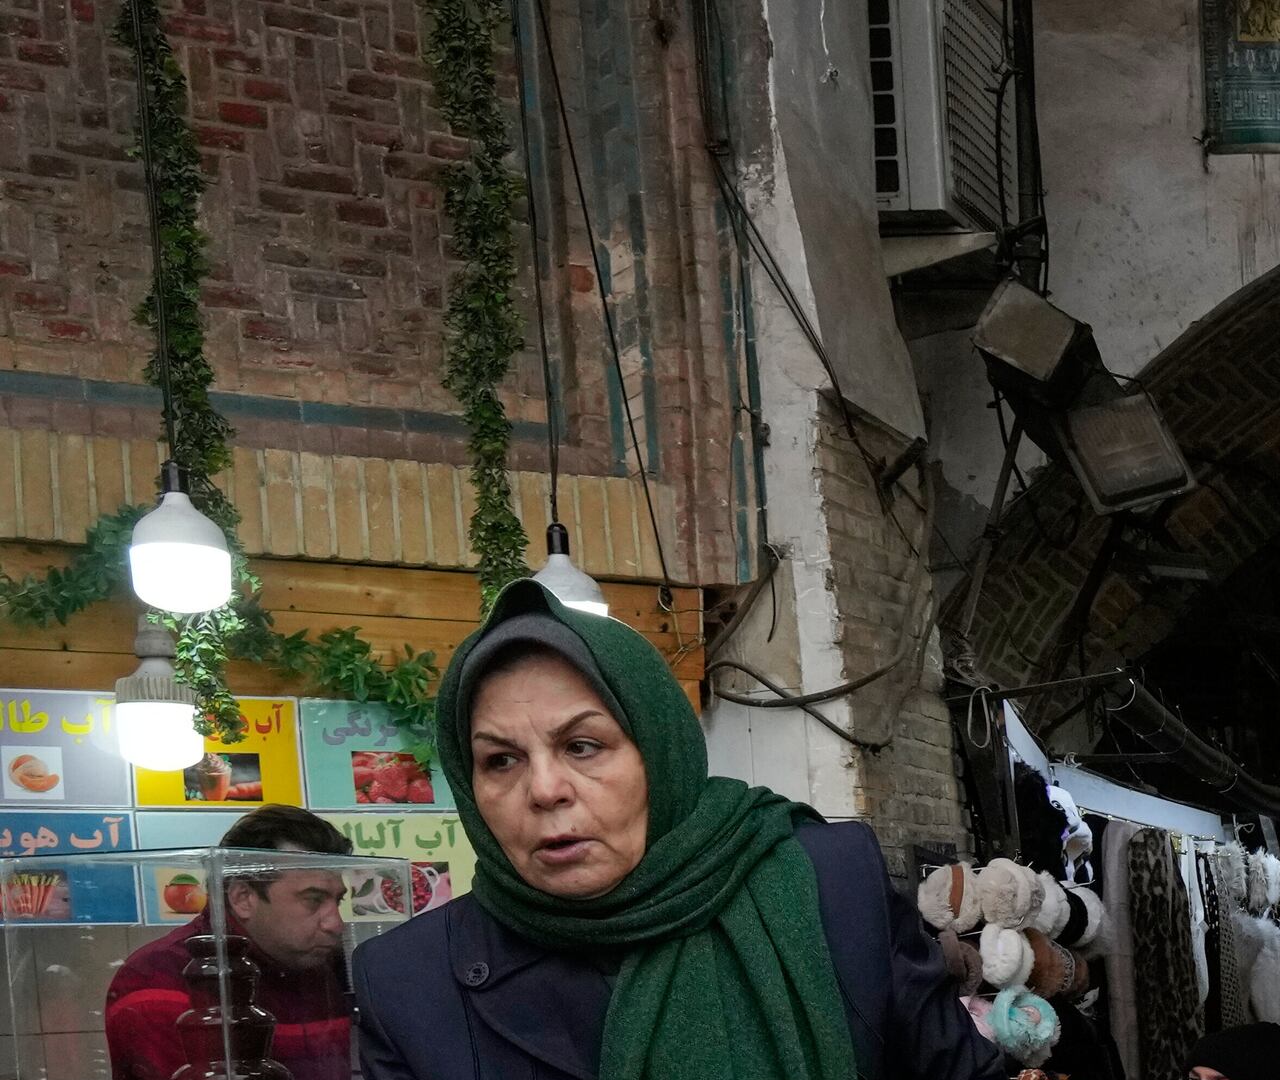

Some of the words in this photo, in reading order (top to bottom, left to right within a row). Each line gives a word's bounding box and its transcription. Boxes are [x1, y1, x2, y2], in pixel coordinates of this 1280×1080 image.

[61, 698, 117, 745] آب
[255, 703, 284, 741] آب
[70, 816, 124, 849] آب
[415, 819, 461, 856] آب
